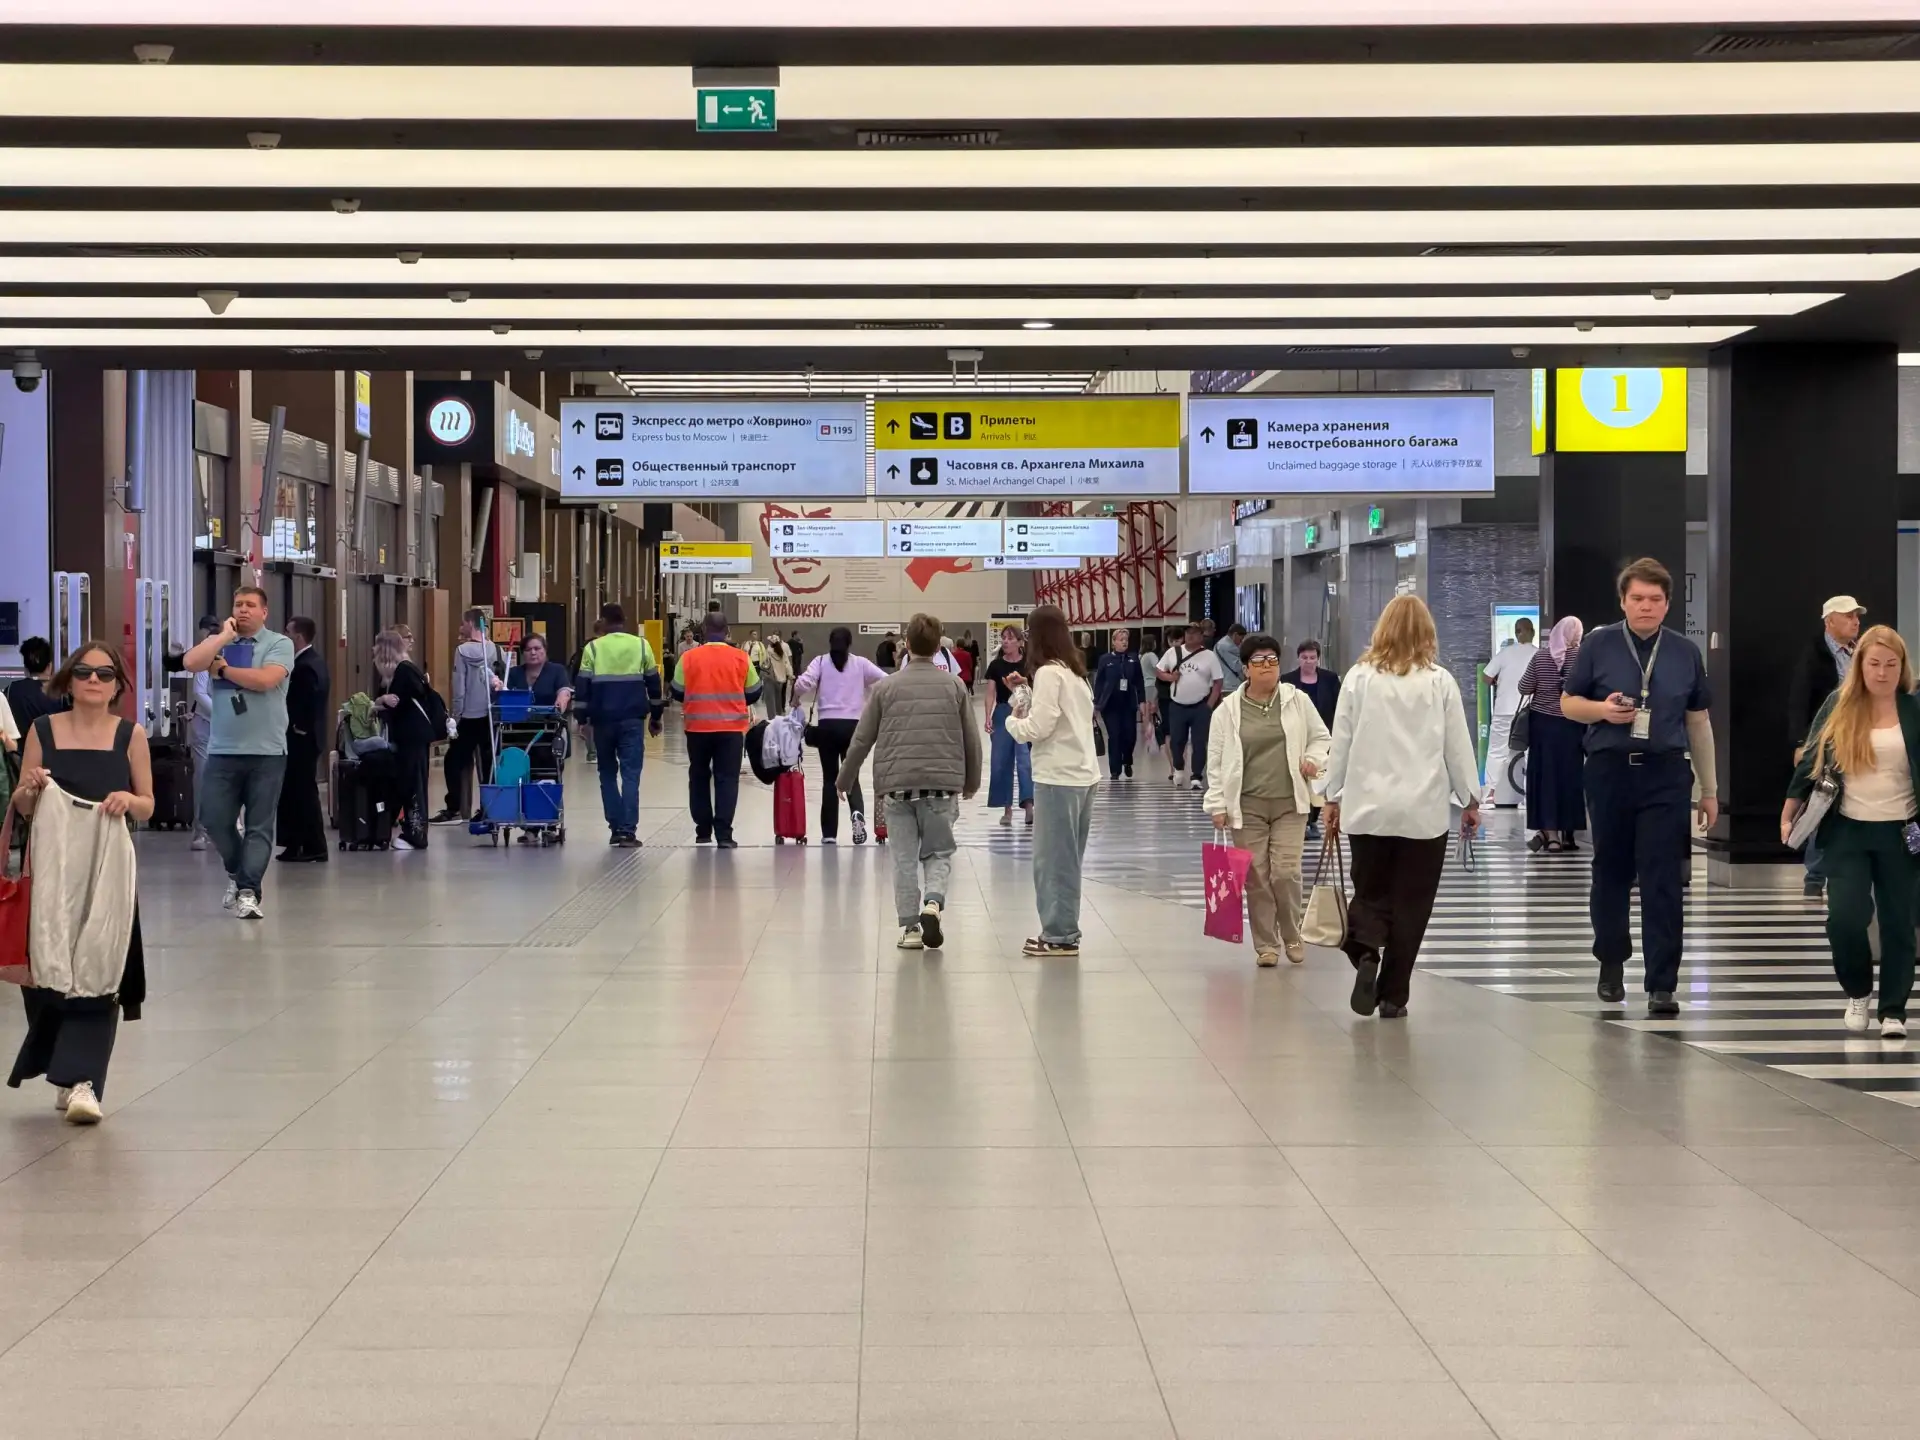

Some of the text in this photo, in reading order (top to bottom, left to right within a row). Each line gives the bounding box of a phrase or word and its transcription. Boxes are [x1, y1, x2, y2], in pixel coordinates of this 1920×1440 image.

[631, 415, 812, 429] Экспресс до метро «Ховрино»
[980, 415, 1036, 428] Прилеты
[1267, 421, 1390, 434] Камера хранения
[832, 426, 853, 435] 1195
[980, 431, 1011, 441] Arrivals
[632, 432, 728, 443] Express bus to Moscow
[1267, 435, 1459, 451] невостребованного багажа
[632, 461, 797, 473] Общественный транспорт
[946, 458, 1145, 472] Часовня св. Архангела Михаила
[1267, 460, 1398, 472] Unclaimed baggage storage
[632, 478, 698, 488] Public transport
[946, 476, 1066, 487] St. Michael Archangel Chapel
[759, 603, 827, 618] MAYAKOVSKY
